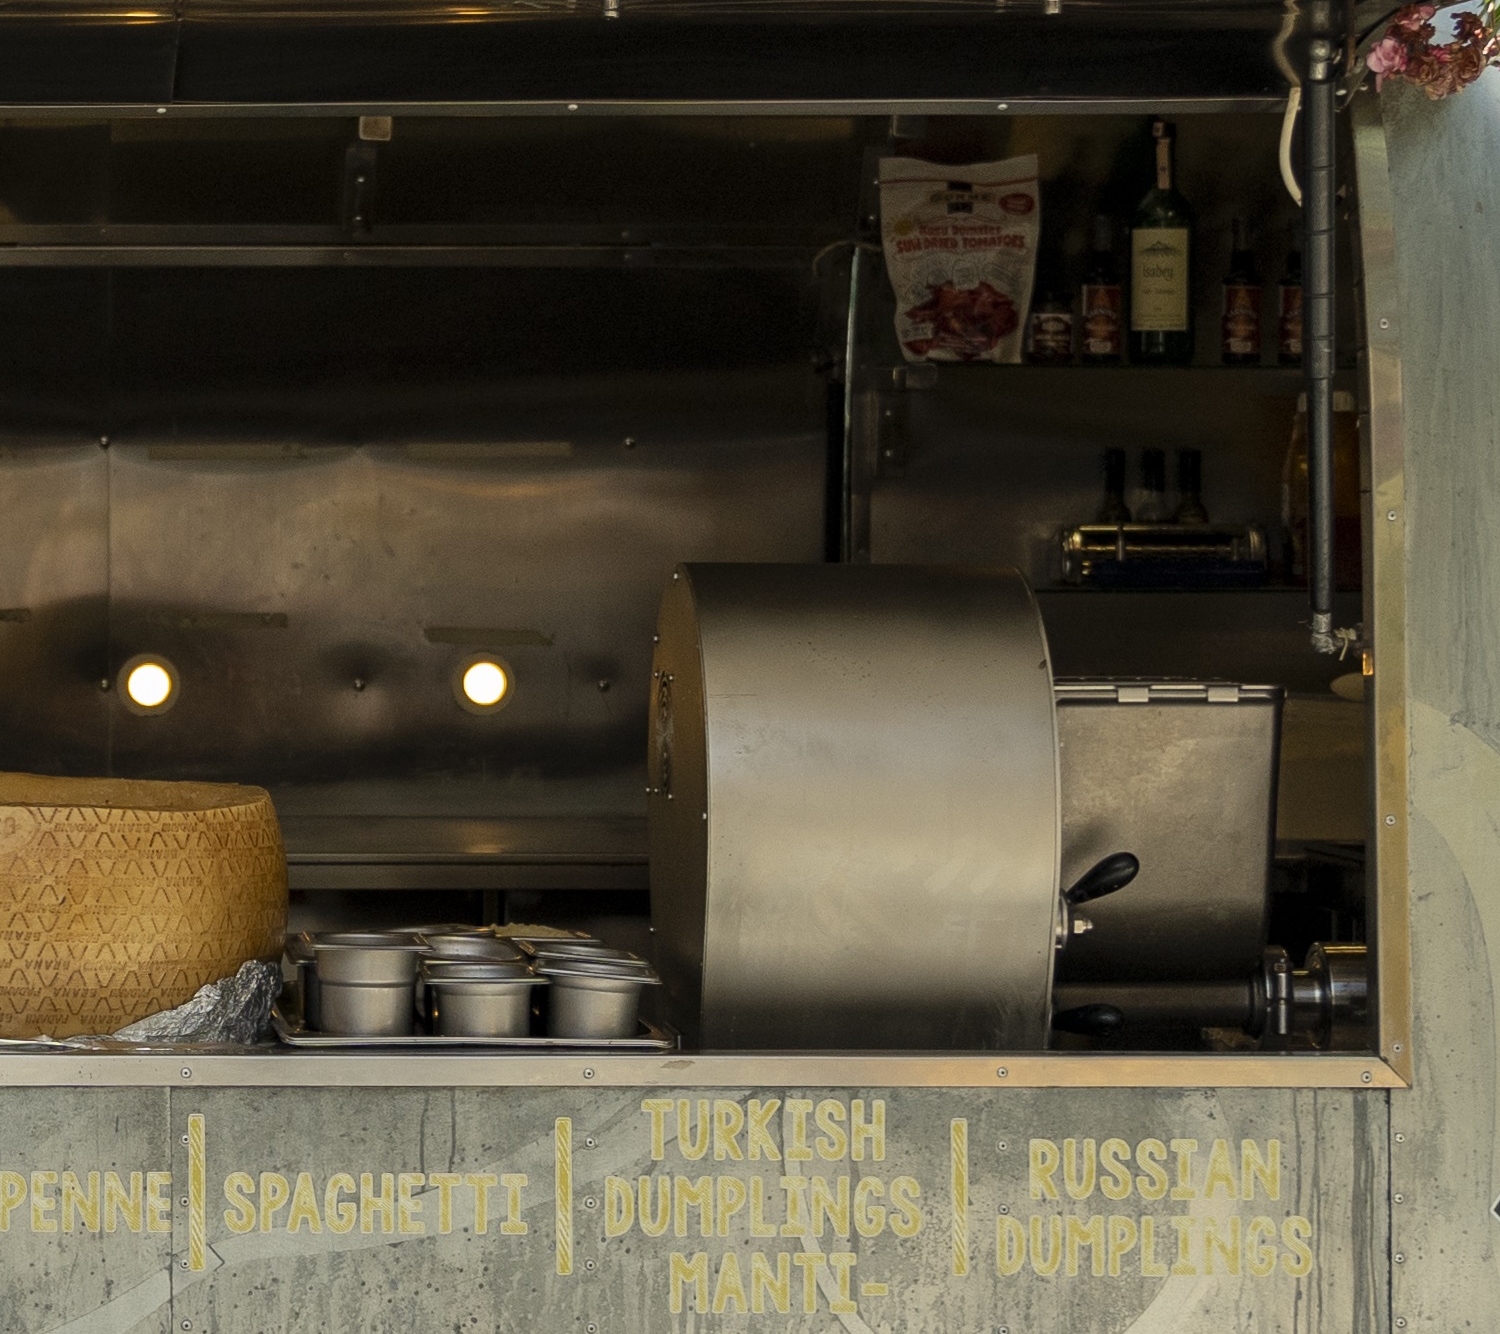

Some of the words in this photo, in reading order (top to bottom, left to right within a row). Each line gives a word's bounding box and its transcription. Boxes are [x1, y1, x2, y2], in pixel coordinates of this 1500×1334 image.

[640, 1099, 886, 1162] TURKISH
[1029, 1138, 1281, 1200] RUSSIAN
[223, 1170, 529, 1236] SPAGHETTI
[605, 1175, 922, 1239] DUMPLINGS
[1000, 1217, 1313, 1277] DUMPLINGS
[669, 1252, 889, 1314] MANTI-
